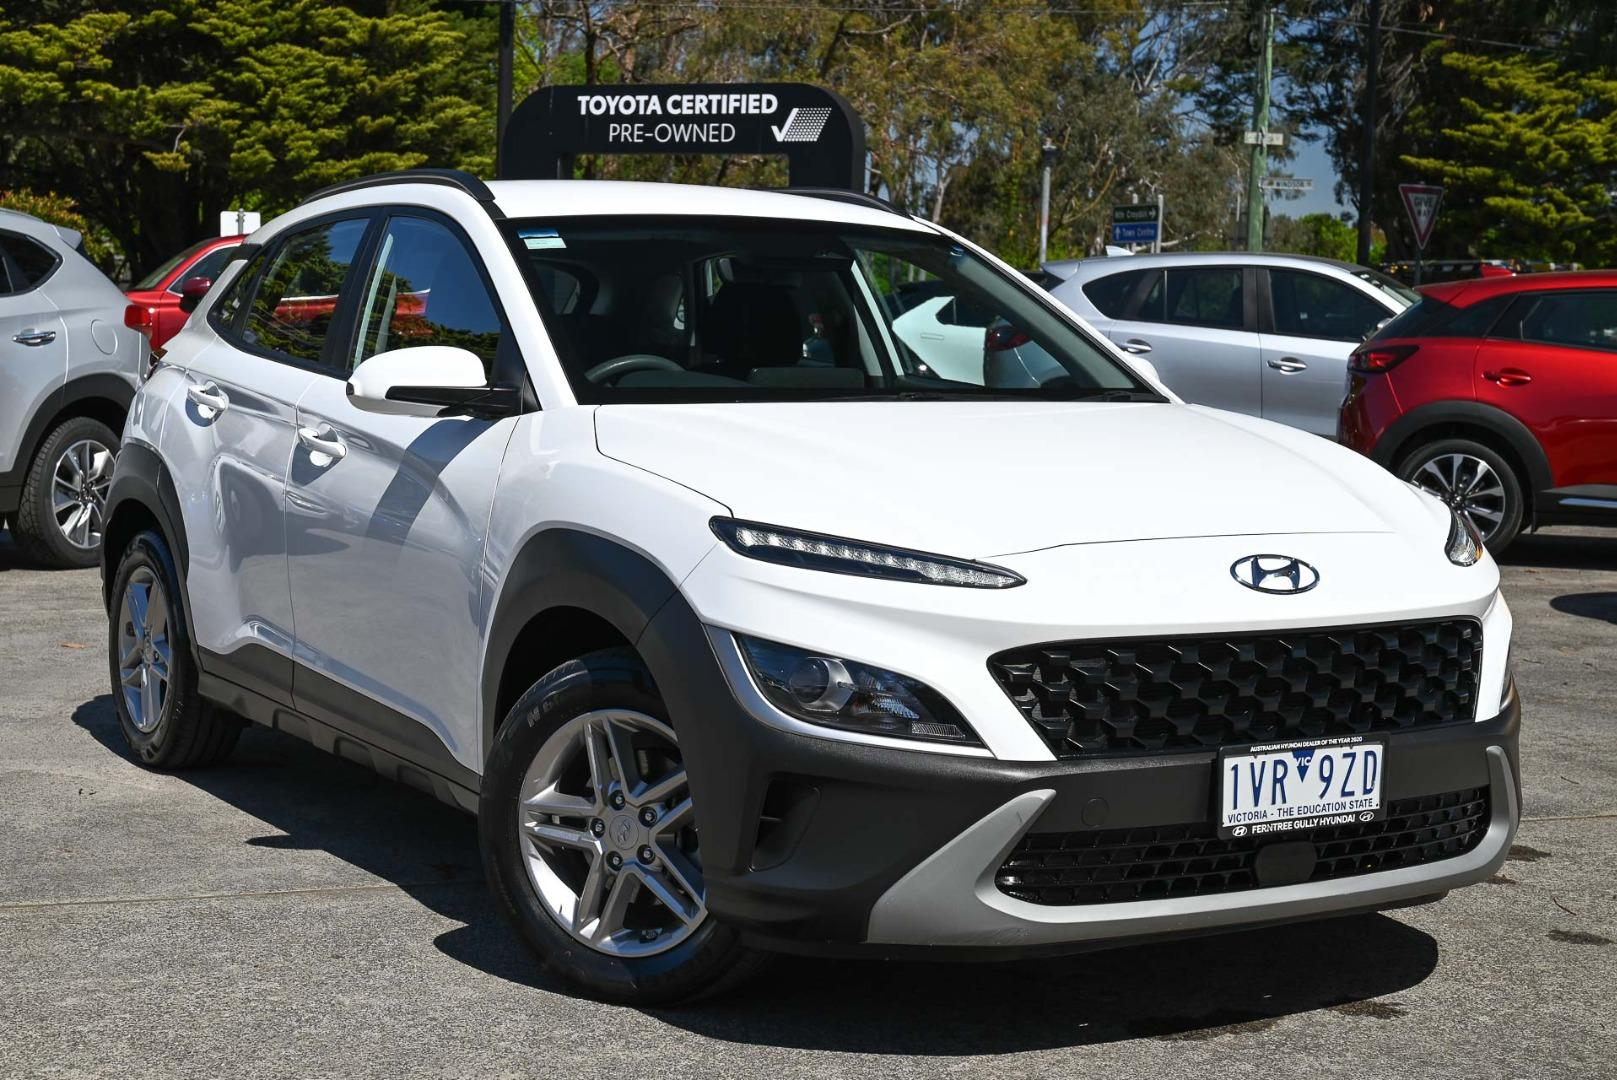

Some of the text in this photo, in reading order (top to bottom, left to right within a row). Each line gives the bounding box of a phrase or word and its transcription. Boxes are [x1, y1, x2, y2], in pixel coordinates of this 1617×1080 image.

[577, 93, 778, 115] TOYOTA CERTIFIED
[608, 123, 736, 143] PRE-OWNED
[1413, 195, 1432, 207] GIVE
[1416, 208, 1431, 217] WAY
[1250, 744, 1280, 752] AUSTRALIAN
[1296, 757, 1312, 767] VIC
[1228, 810, 1268, 823] VICTORIA
[1277, 807, 1294, 818] THE
[1297, 801, 1346, 815] EDUCATION
[1349, 798, 1373, 810] STATE
[1252, 814, 1355, 834] FERNTREE GULLY HYUNDAI
